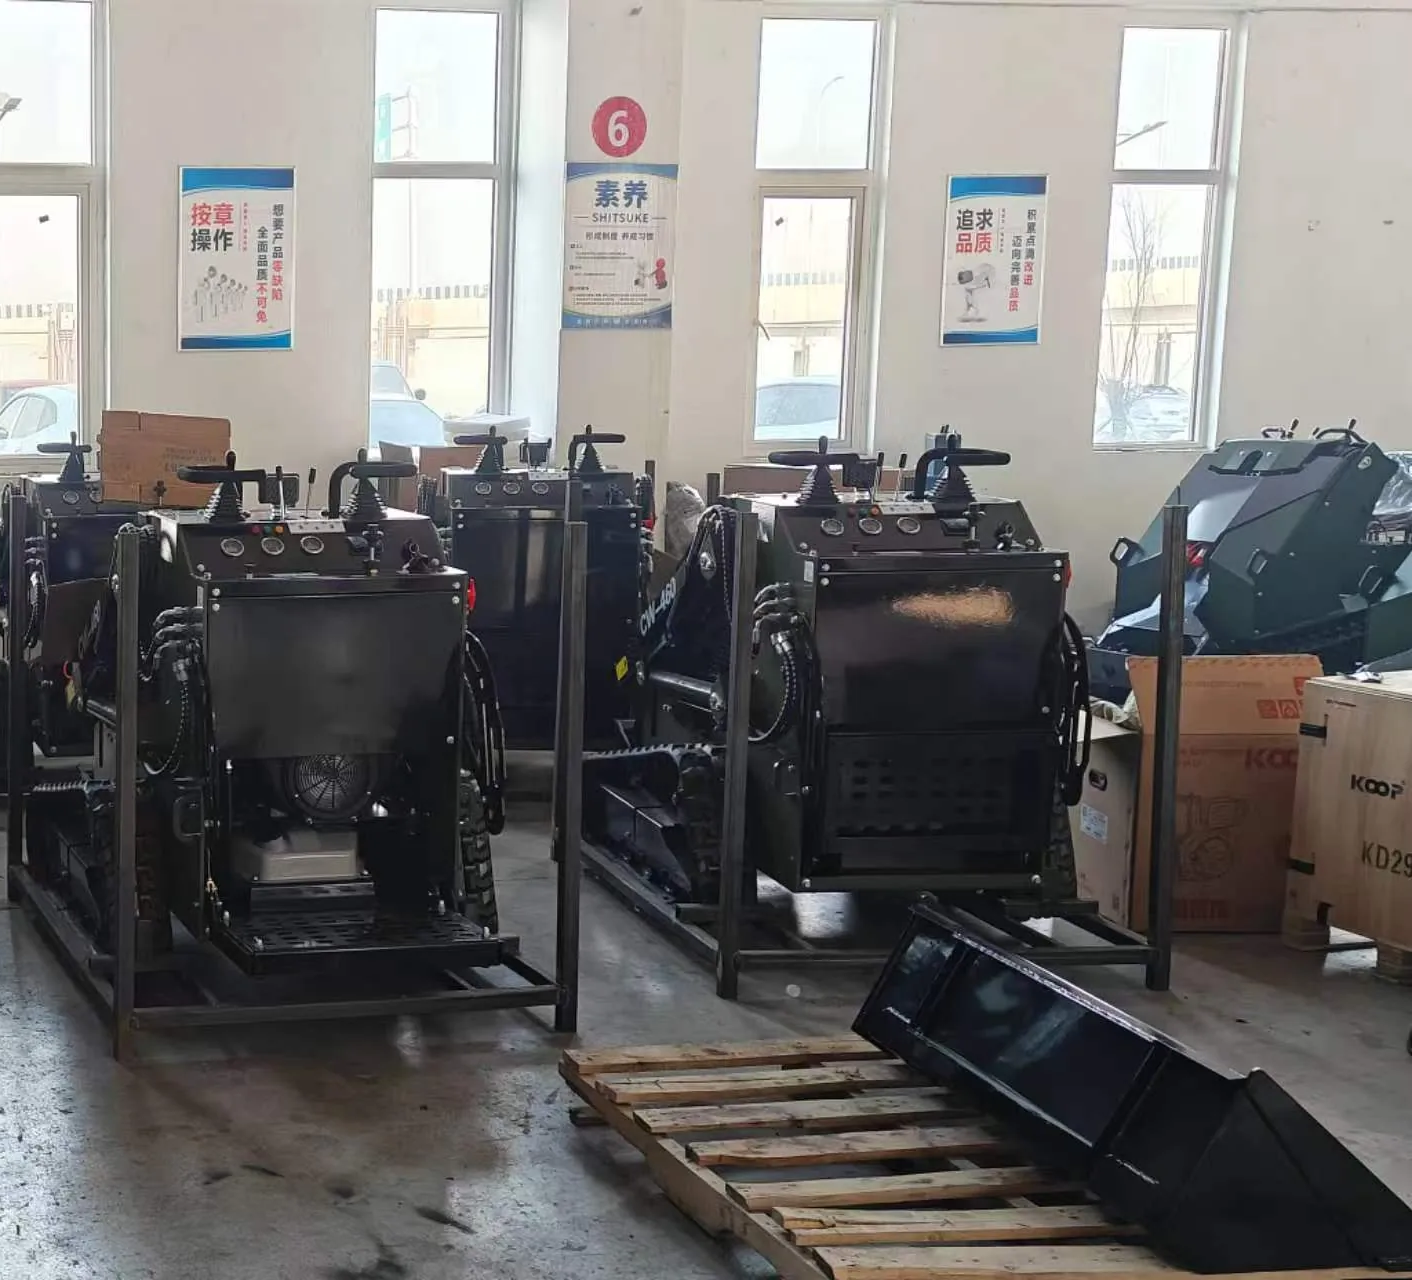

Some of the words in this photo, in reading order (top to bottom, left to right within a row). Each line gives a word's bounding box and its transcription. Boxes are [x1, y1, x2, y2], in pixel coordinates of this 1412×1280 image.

[608, 110, 630, 147] 6
[594, 180, 648, 208] 素养
[191, 202, 234, 226] 按章
[592, 213, 649, 223] SHITSUKE
[956, 208, 994, 231] 追求
[191, 228, 234, 252] 操作
[272, 204, 284, 301] 想要产品零缺陷
[955, 233, 993, 253] 品质
[1023, 209, 1037, 286] 积累点滴改进
[256, 226, 269, 323] 全面品质不可免
[1009, 235, 1023, 312] 迈向完善品质
[640, 577, 676, 636] CW-460
[1351, 774, 1404, 800] KOOP
